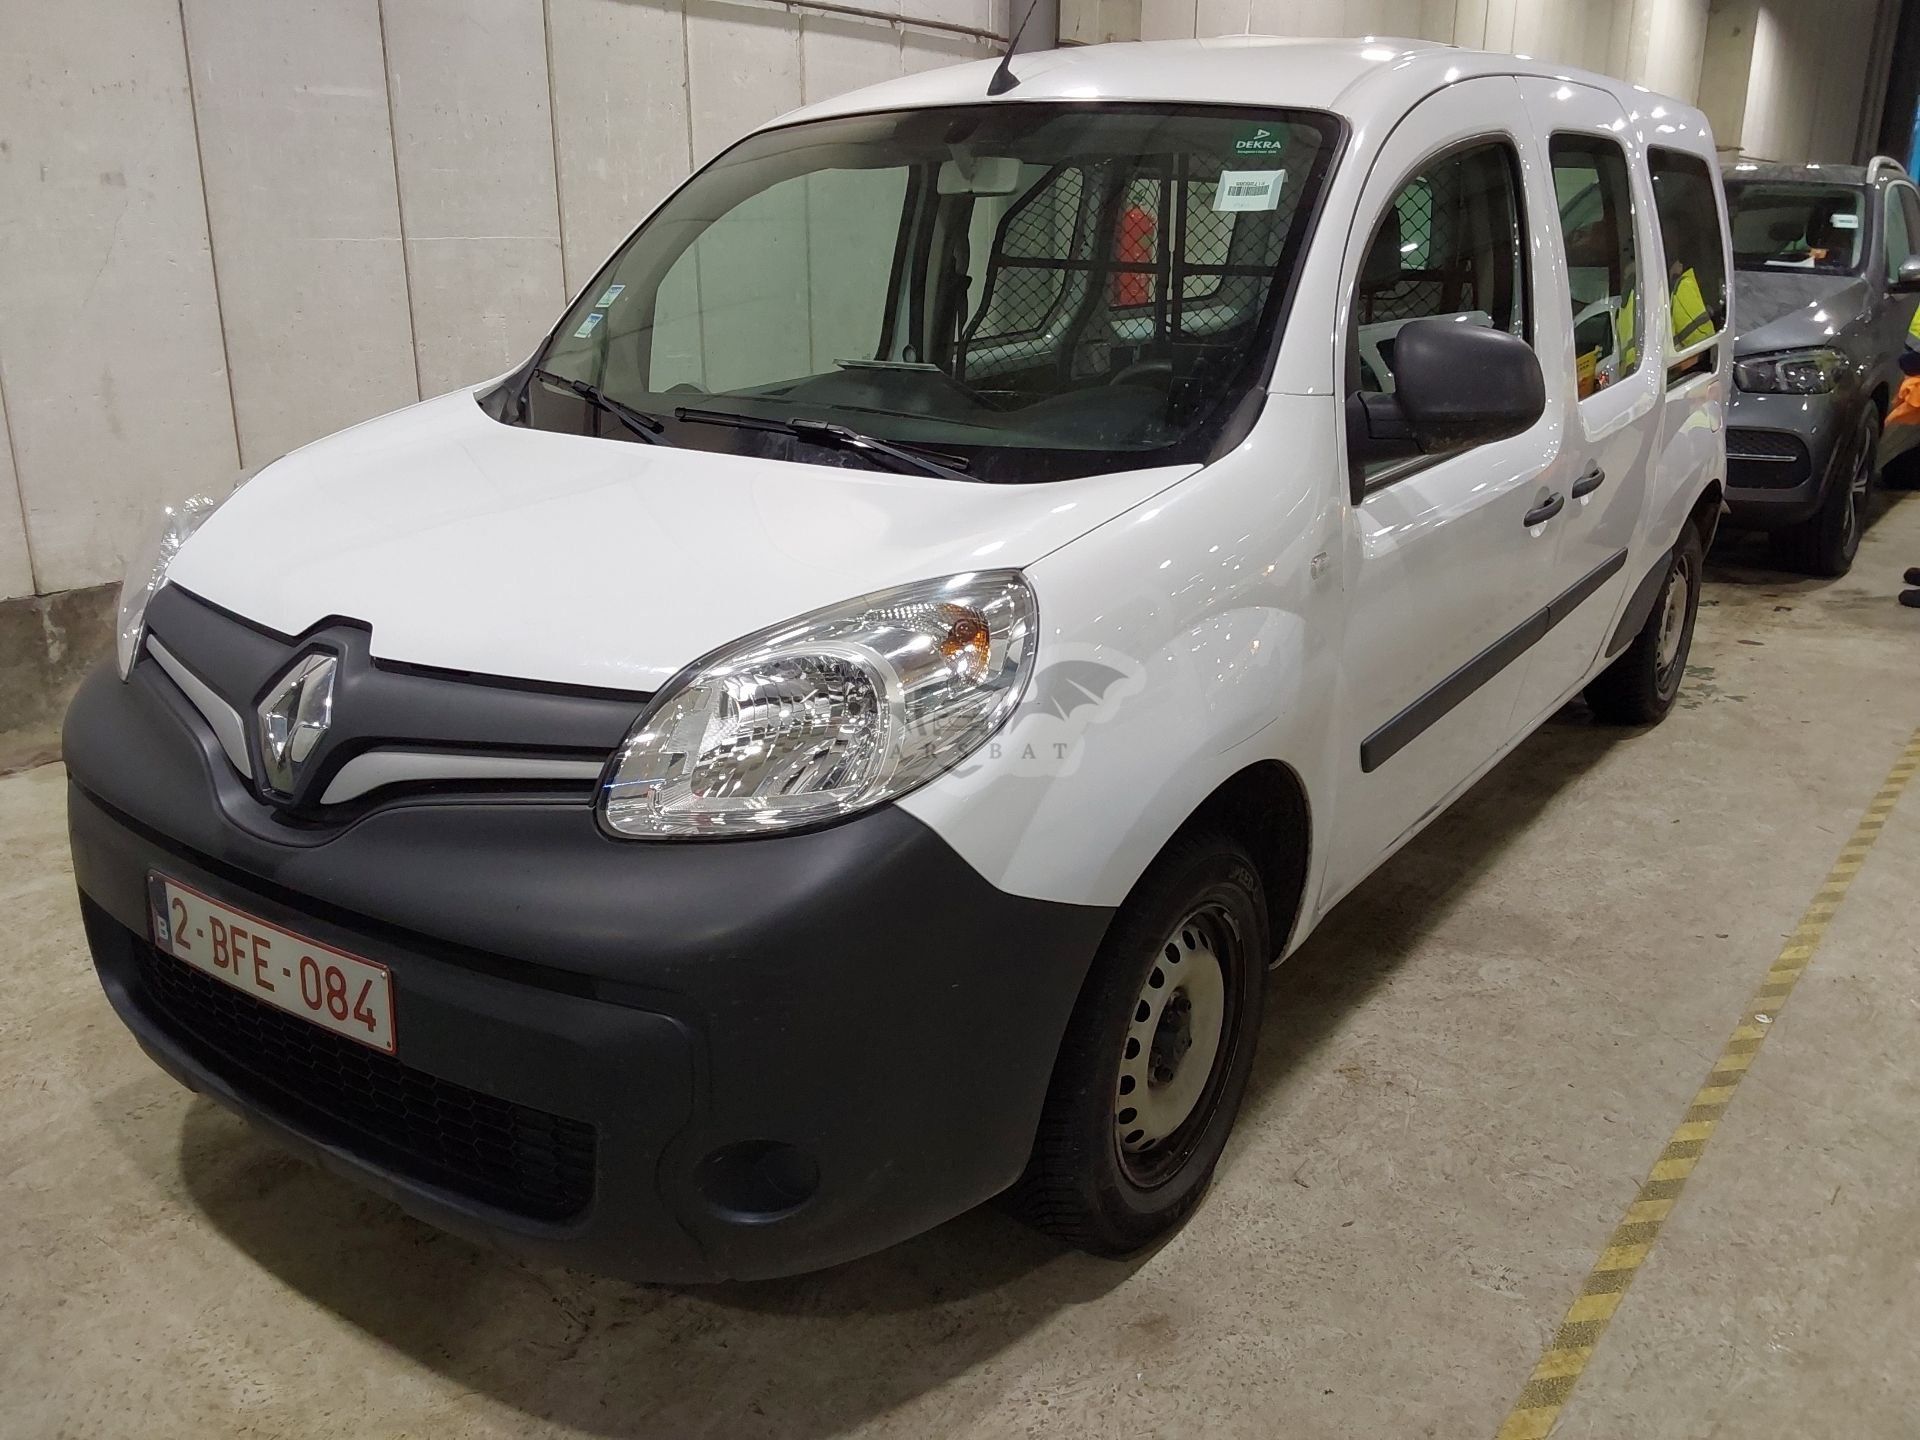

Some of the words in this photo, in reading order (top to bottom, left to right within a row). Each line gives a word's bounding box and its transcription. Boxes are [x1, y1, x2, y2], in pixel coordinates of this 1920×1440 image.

[1235, 140, 1281, 149] DEKRA
[156, 914, 169, 940] B
[172, 897, 377, 1032] 2-BFE-084
